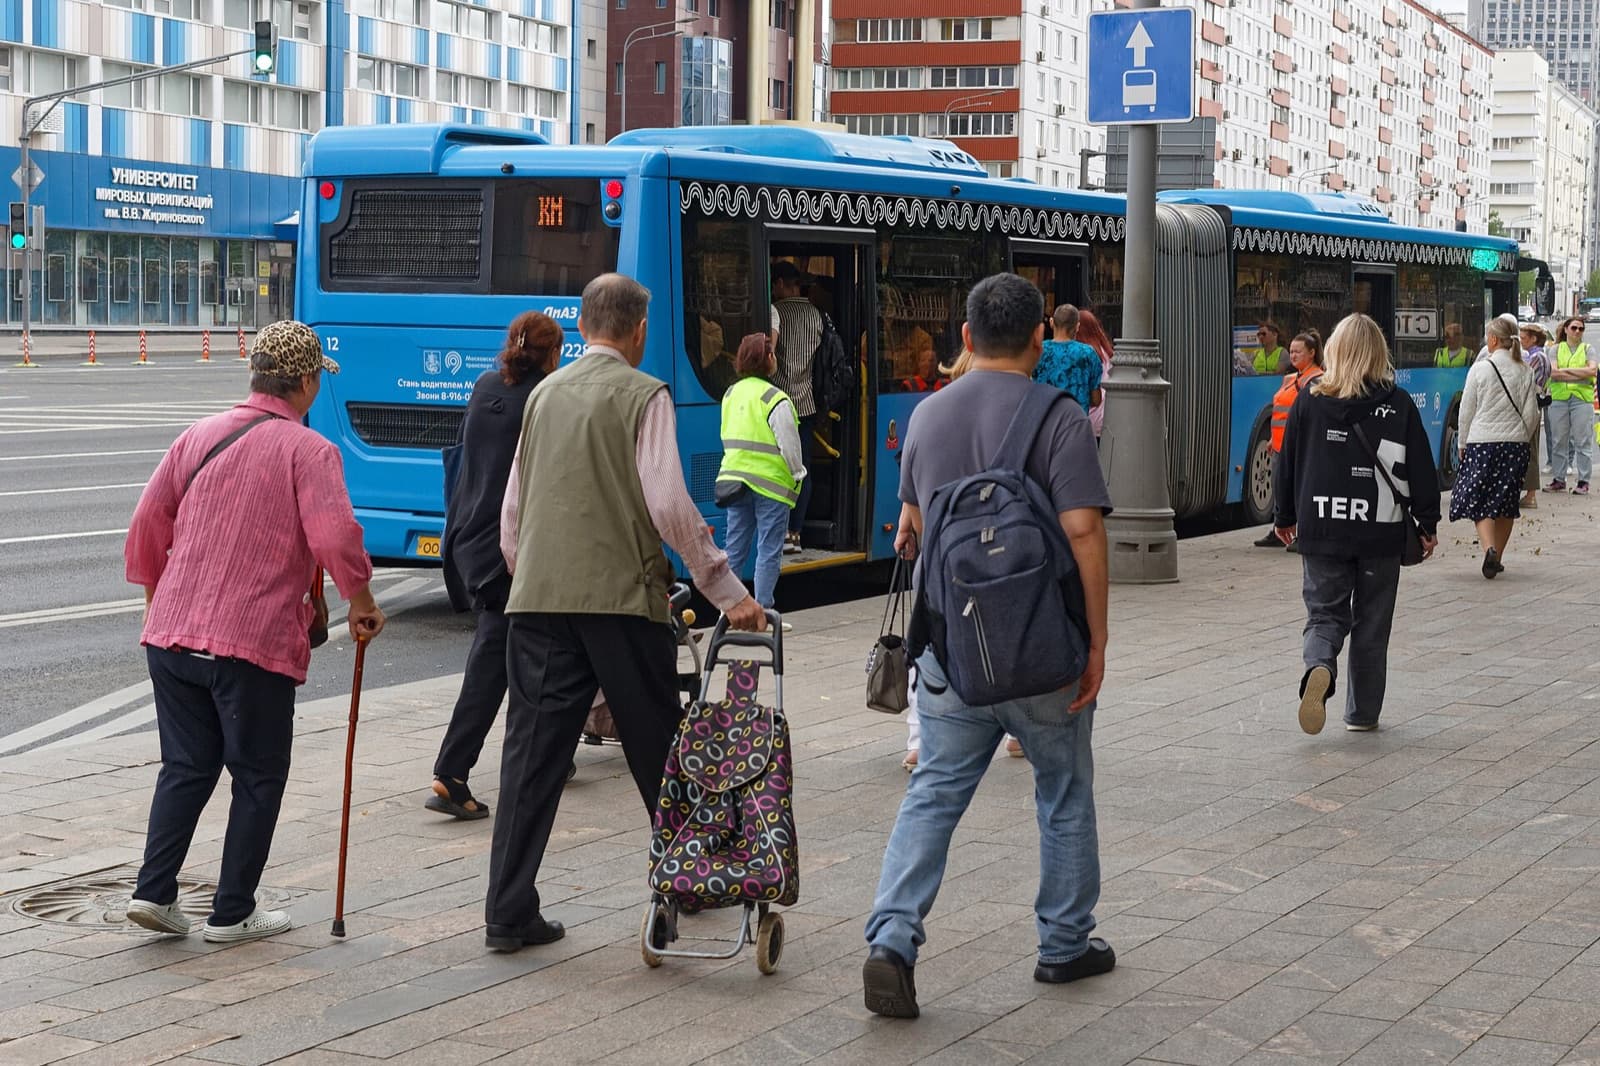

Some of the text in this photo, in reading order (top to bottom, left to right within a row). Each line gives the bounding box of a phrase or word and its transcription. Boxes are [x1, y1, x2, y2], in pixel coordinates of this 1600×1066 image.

[112, 167, 198, 190] УНИВЕРСИТЕТ
[95, 187, 213, 210] МИРОВЫХ ЦИВИЛИЗАЦИЙ
[104, 206, 204, 224] им. В.В. Жириновского
[538, 196, 563, 226] КМ
[326, 336, 340, 351] 12
[397, 378, 420, 388] Стань
[420, 381, 463, 390] водителем
[416, 391, 440, 401] Звони
[1312, 495, 1369, 521] TER
